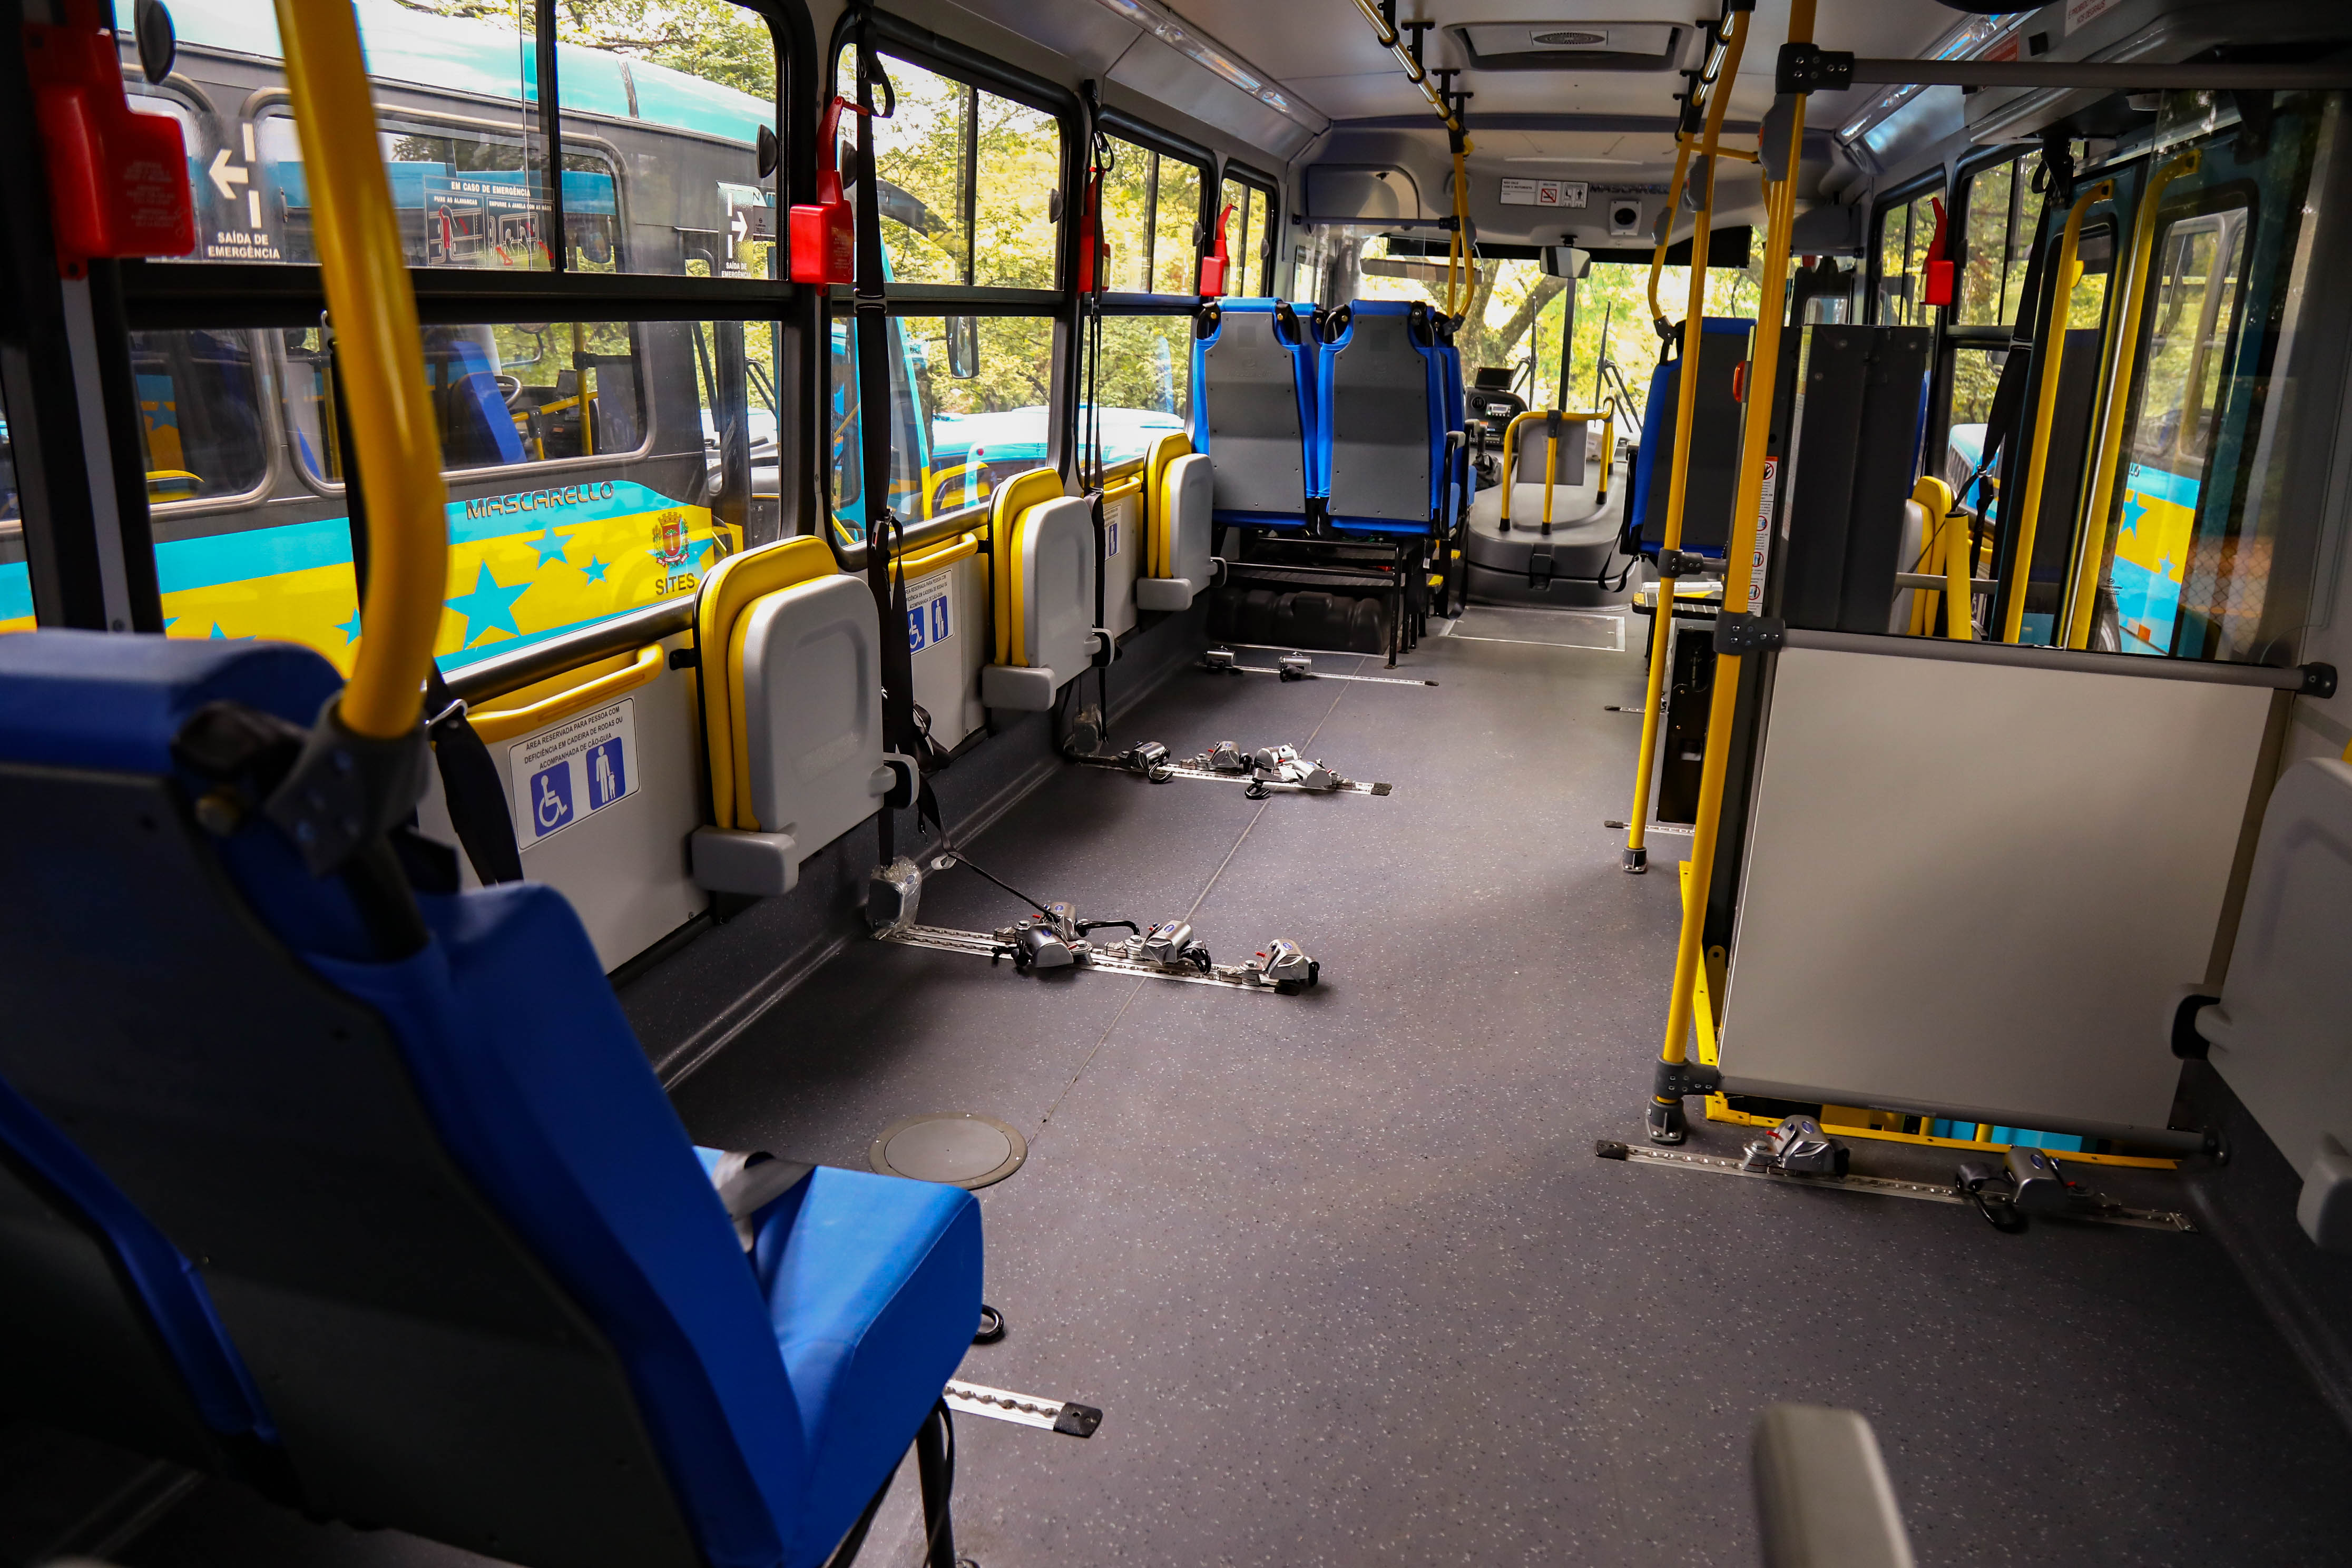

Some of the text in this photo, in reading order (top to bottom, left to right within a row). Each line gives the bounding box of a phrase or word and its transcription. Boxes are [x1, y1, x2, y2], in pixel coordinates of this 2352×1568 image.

[452, 181, 531, 197] EM CASO DE EMERGÊNCIA
[218, 230, 269, 245] SAÍDA DE
[208, 244, 281, 259] EMERGÊNCIA
[726, 261, 740, 269] SAÍDA
[465, 481, 614, 520] MASCARELLO
[655, 572, 695, 595] SITES
[524, 746, 557, 764] DEFICIÊNCIA
[558, 740, 566, 750] EM
[567, 731, 590, 746] CADEIRA
[598, 720, 615, 732] RODAS
[615, 716, 623, 724] OU
[526, 706, 620, 751] ÁREA RESERVADA PARA PESSOA COM
[540, 733, 612, 770] ACOMPANHADA DE CÃO-GUIA
